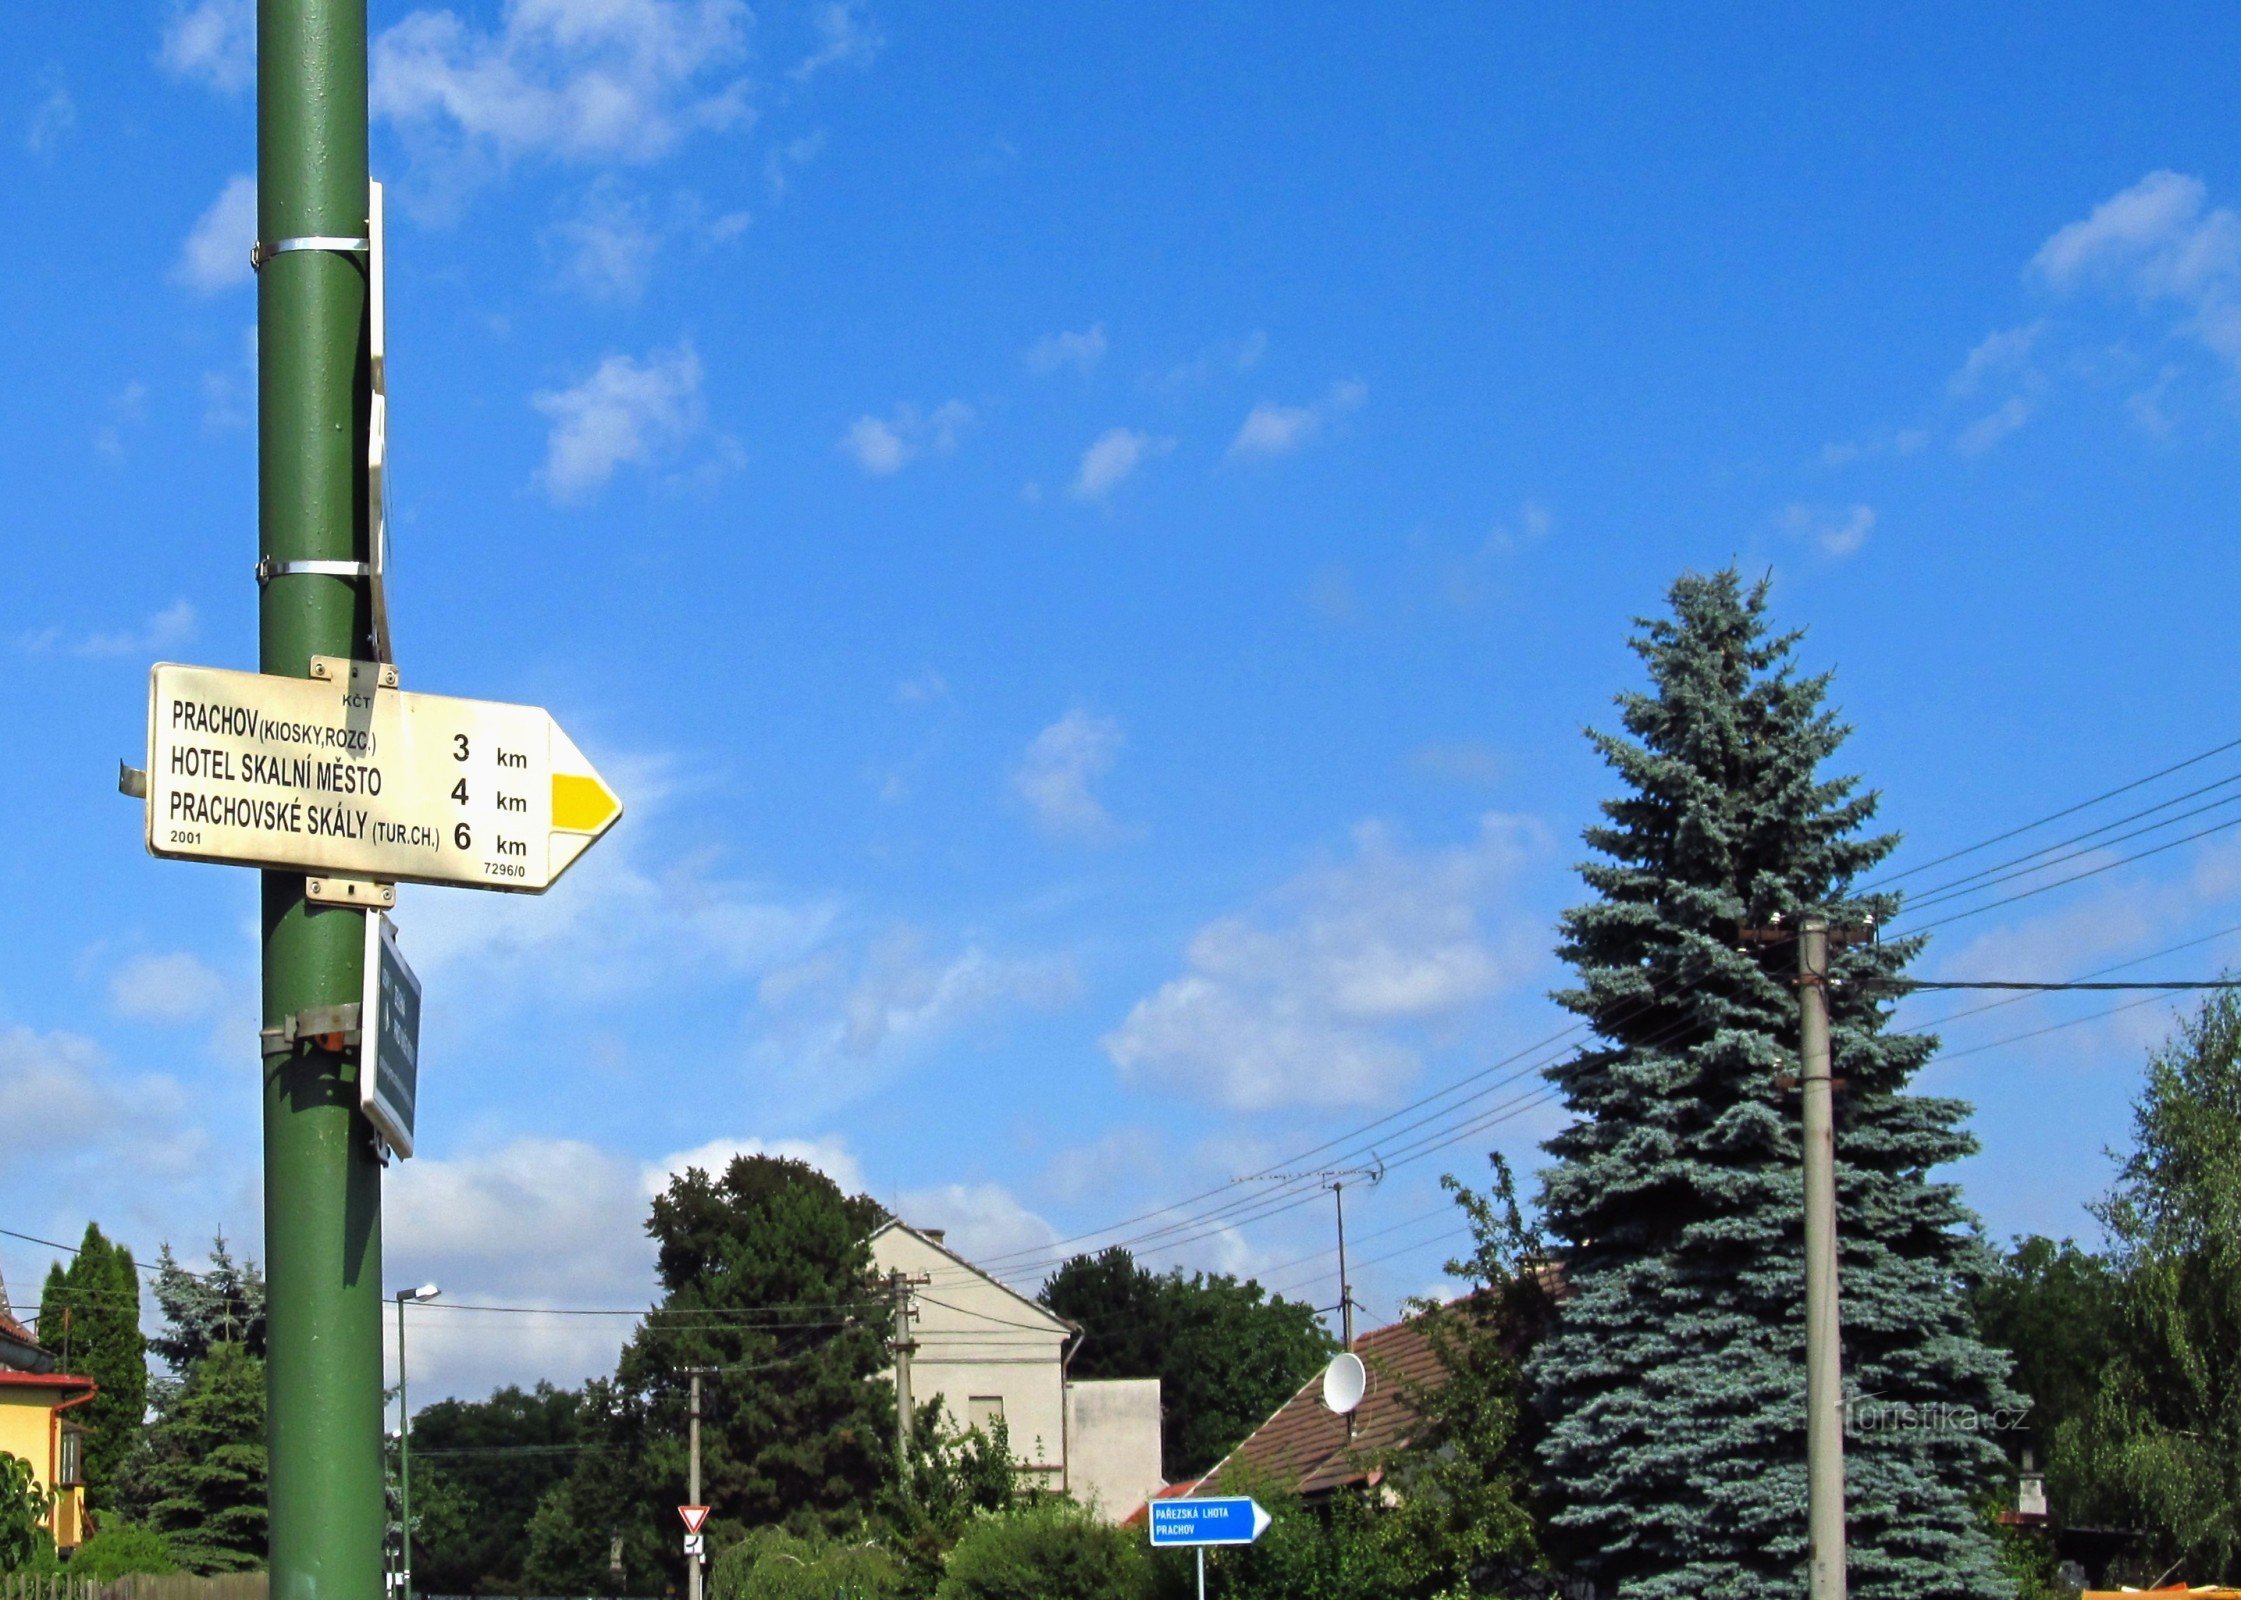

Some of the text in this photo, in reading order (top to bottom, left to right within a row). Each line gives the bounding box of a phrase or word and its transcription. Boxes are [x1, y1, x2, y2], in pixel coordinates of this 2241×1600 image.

[343, 694, 370, 709] KČT
[173, 701, 258, 737] PRACHOV
[453, 734, 469, 762] 3
[497, 747, 527, 769] km
[172, 746, 527, 813] HOTEL SKALNÍ MĚSTO 4 km
[170, 791, 527, 856] PRACHOVSKÉ SKÁLY (TUR.CH.) 6 km
[171, 831, 201, 845] 2001
[484, 862, 525, 878] 7296/0
[1156, 1507, 1229, 1520] PAŘEZSKÁ LHOTA
[1156, 1524, 1195, 1535] PRACHOV
